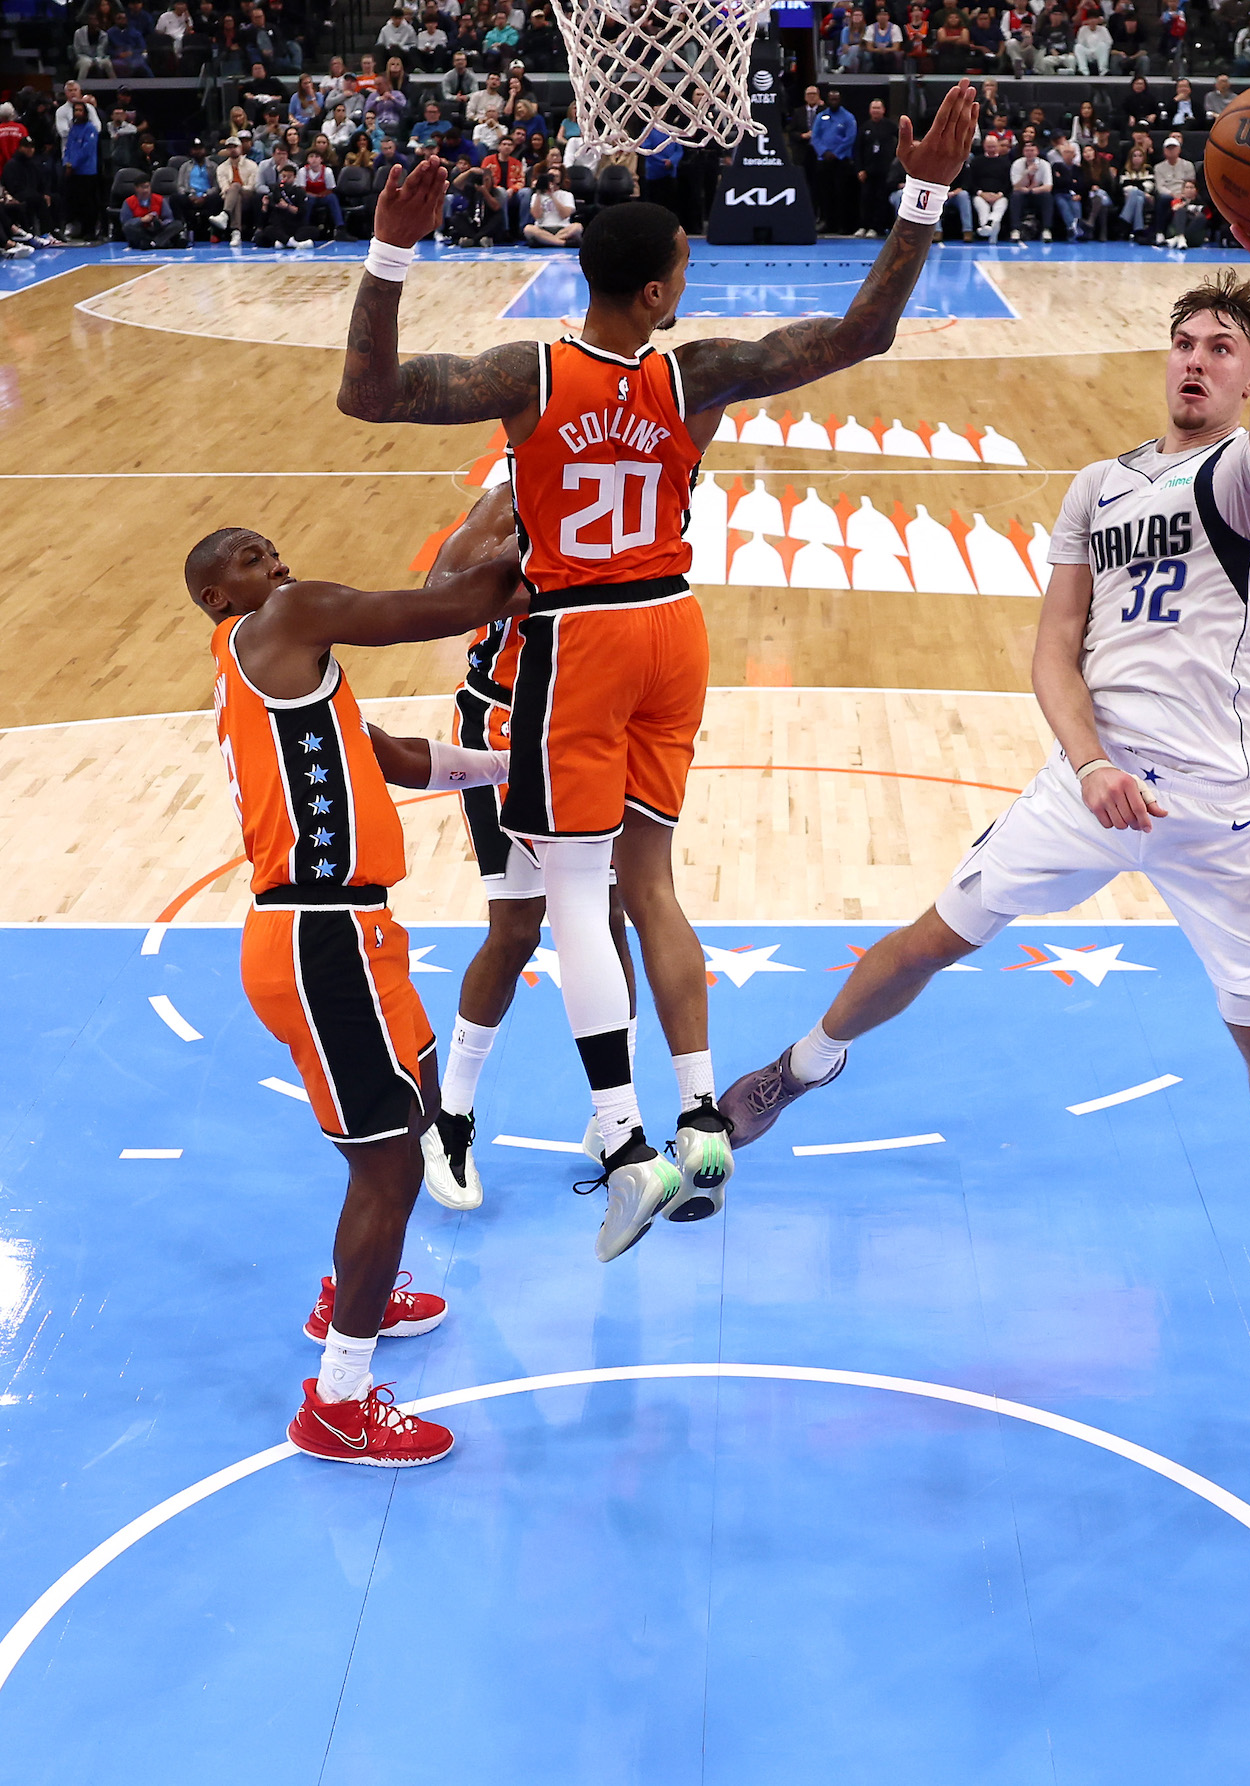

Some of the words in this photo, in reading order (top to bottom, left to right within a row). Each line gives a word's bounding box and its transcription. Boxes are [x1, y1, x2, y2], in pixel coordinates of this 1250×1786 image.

[751, 93, 777, 103] AT&T
[725, 187, 796, 206] KIA
[560, 460, 663, 559] 20
[1121, 558, 1188, 623] 32
